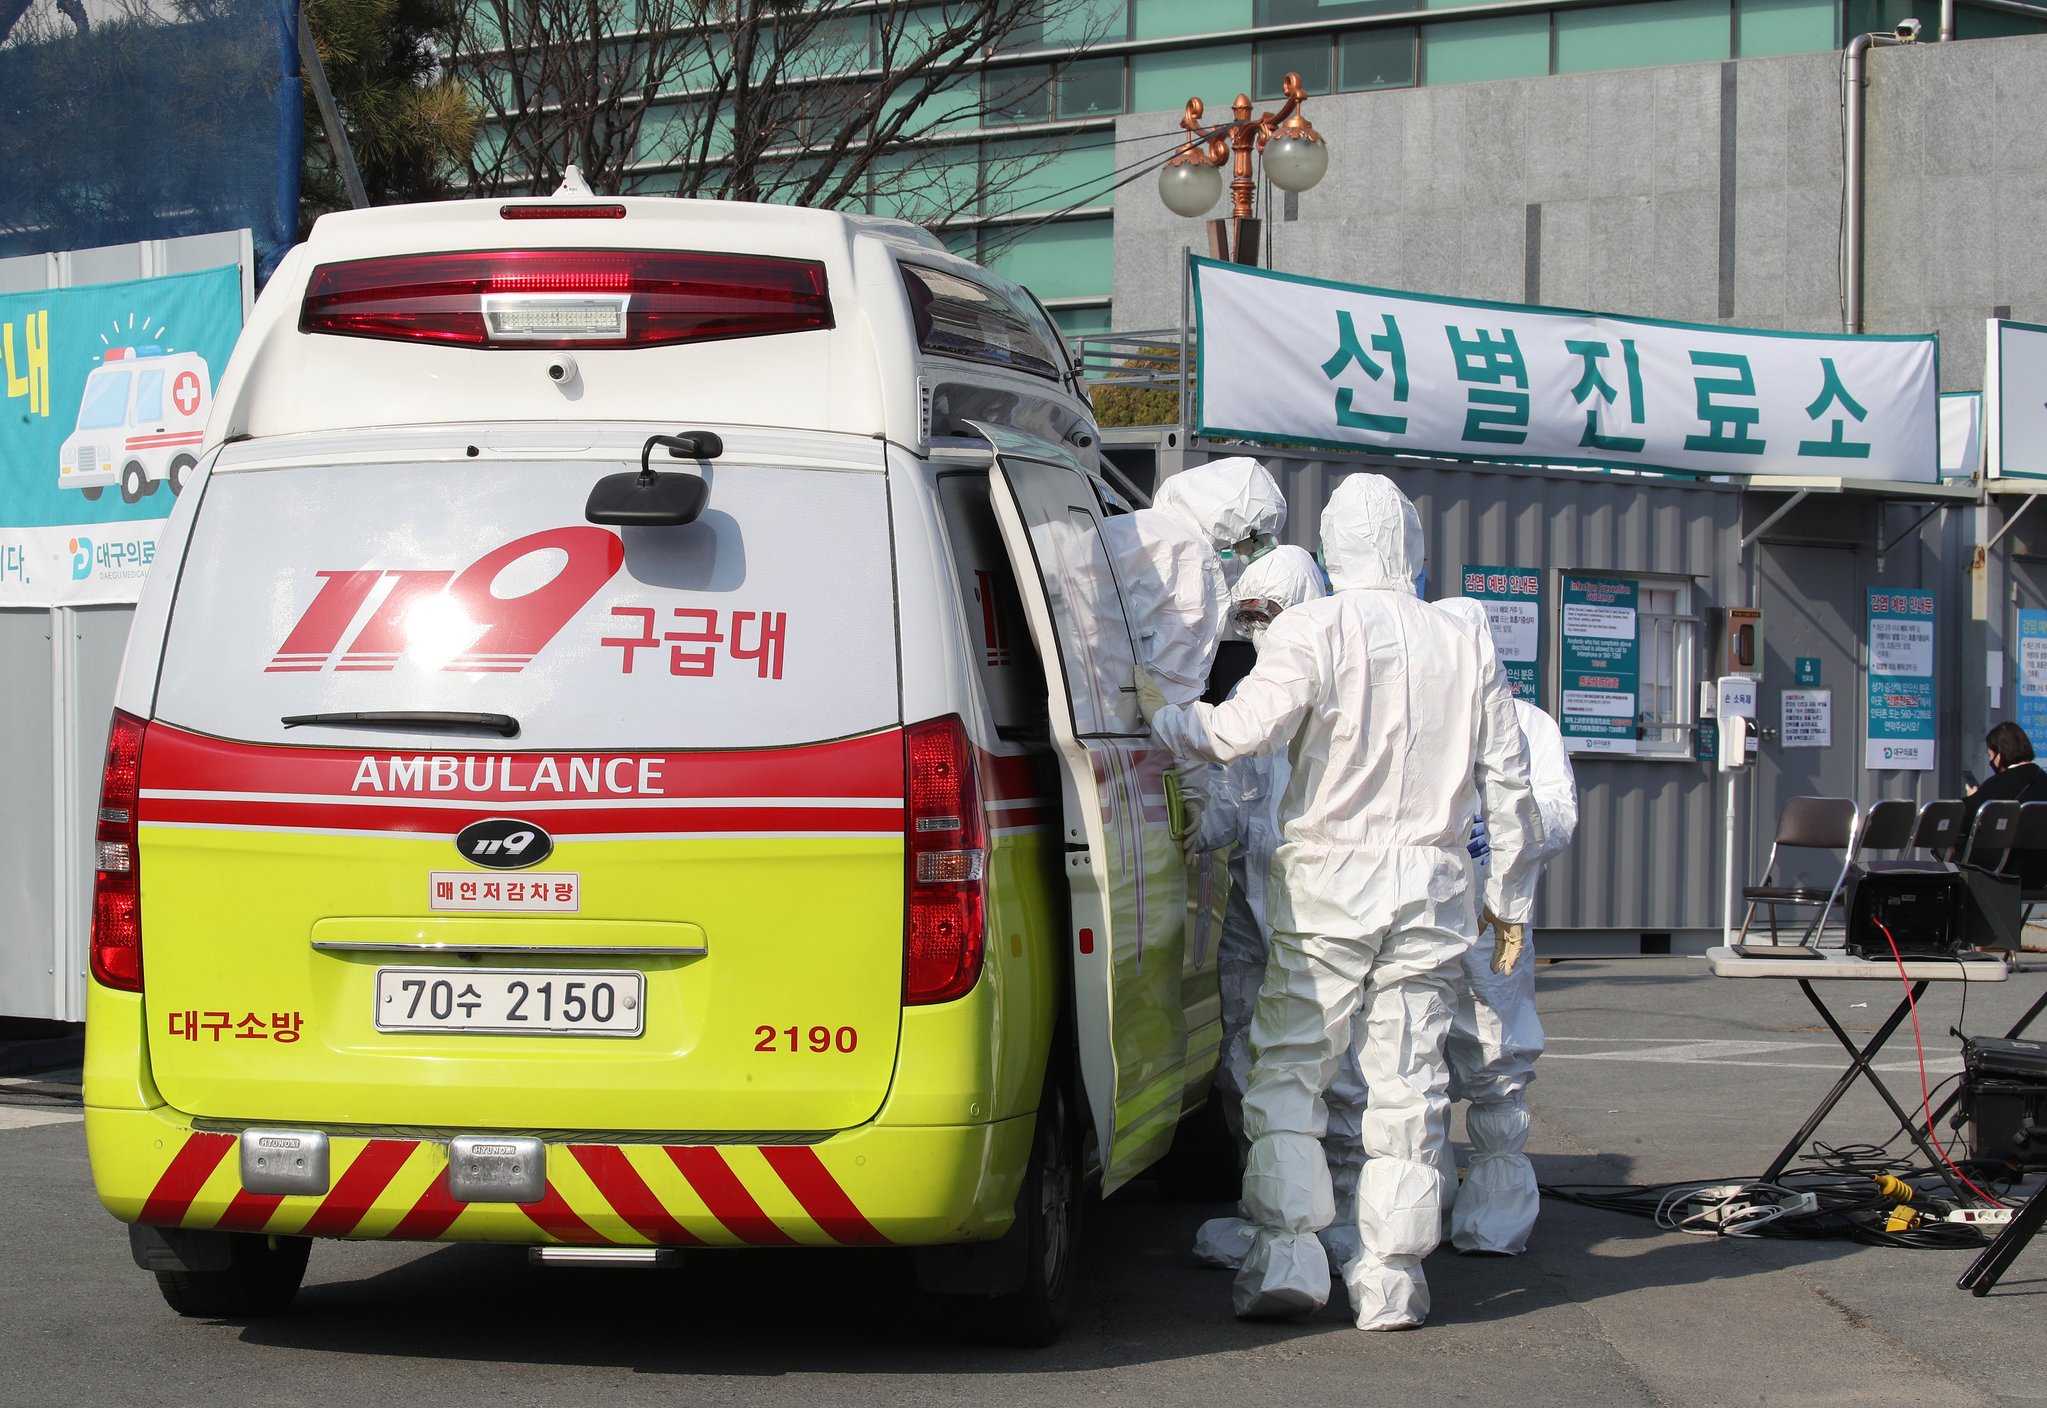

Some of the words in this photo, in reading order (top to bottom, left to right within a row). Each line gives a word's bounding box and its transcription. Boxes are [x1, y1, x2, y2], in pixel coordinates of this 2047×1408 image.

[0, 310, 49, 417] 내
[1321, 310, 1871, 458] 선별진료소
[0, 545, 30, 584] 다.
[100, 571, 122, 580] DAEGU
[1465, 574, 1485, 592] 감염
[1487, 574, 1507, 593] 예방
[1509, 575, 1538, 594] 안내문
[264, 526, 624, 673] 119
[1871, 594, 1889, 612] 감염
[1890, 596, 1907, 613] 예방
[1909, 597, 1934, 614] 안내문
[601, 606, 787, 680] 구급대
[1521, 669, 1534, 680] 분은
[1724, 694, 1731, 704] 손
[1733, 694, 1751, 704] 소독제
[1872, 682, 1883, 692] 상기
[1902, 683, 1918, 693] 있으신
[1870, 708, 1887, 719] 인터폰
[1889, 709, 1899, 719] 또는
[1893, 748, 1918, 756] 대구의료원
[351, 756, 666, 795] AMBULANCE
[472, 831, 535, 855] 119
[436, 881, 573, 902] 매연저감차량
[402, 980, 482, 1019] 70수
[506, 981, 615, 1023] 2150
[169, 1011, 304, 1043] 대구소방
[754, 1025, 858, 1053] 2190
